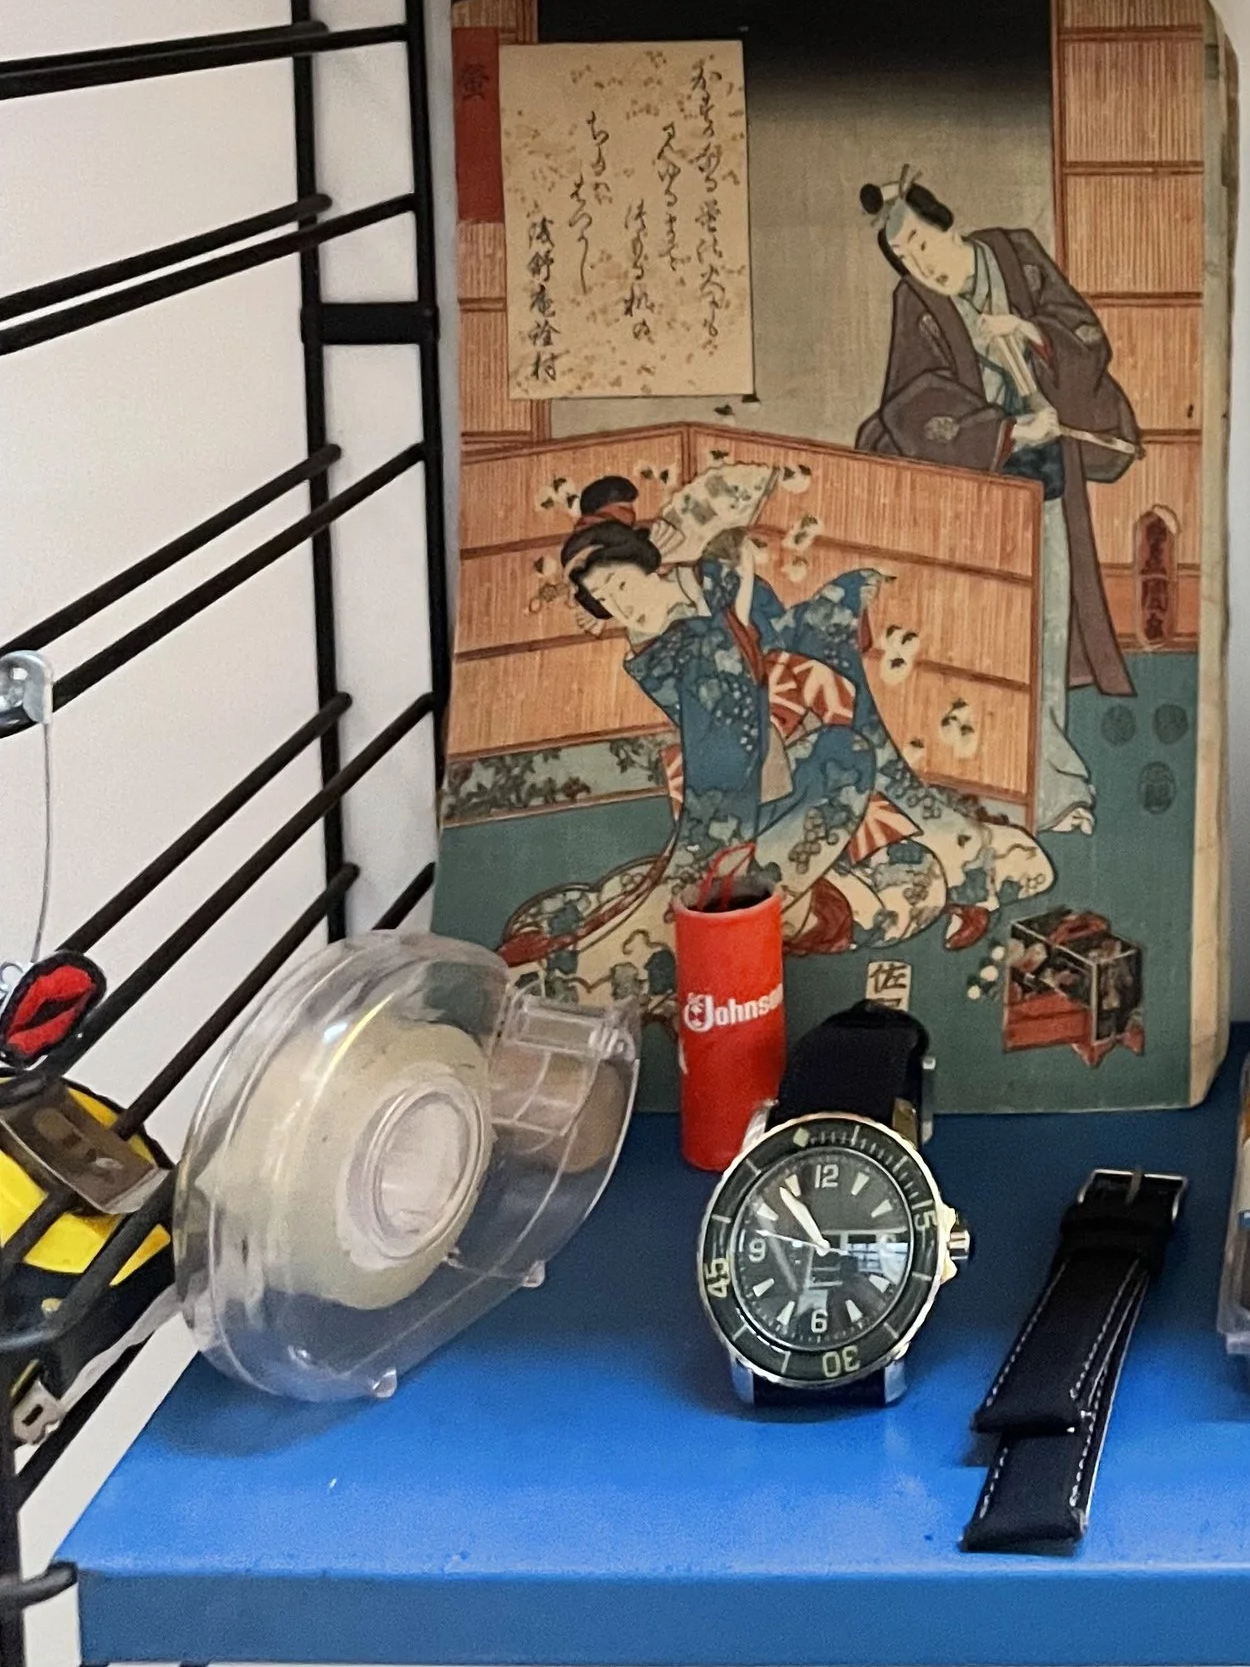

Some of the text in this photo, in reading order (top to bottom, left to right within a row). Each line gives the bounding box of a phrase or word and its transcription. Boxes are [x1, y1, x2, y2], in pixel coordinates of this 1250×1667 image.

[814, 1164, 839, 1188] 12
[912, 1199, 938, 1230] 15
[748, 1239, 766, 1262] 9
[705, 1258, 731, 1298] 45
[811, 1309, 827, 1333] 6
[821, 1345, 861, 1377] 30
